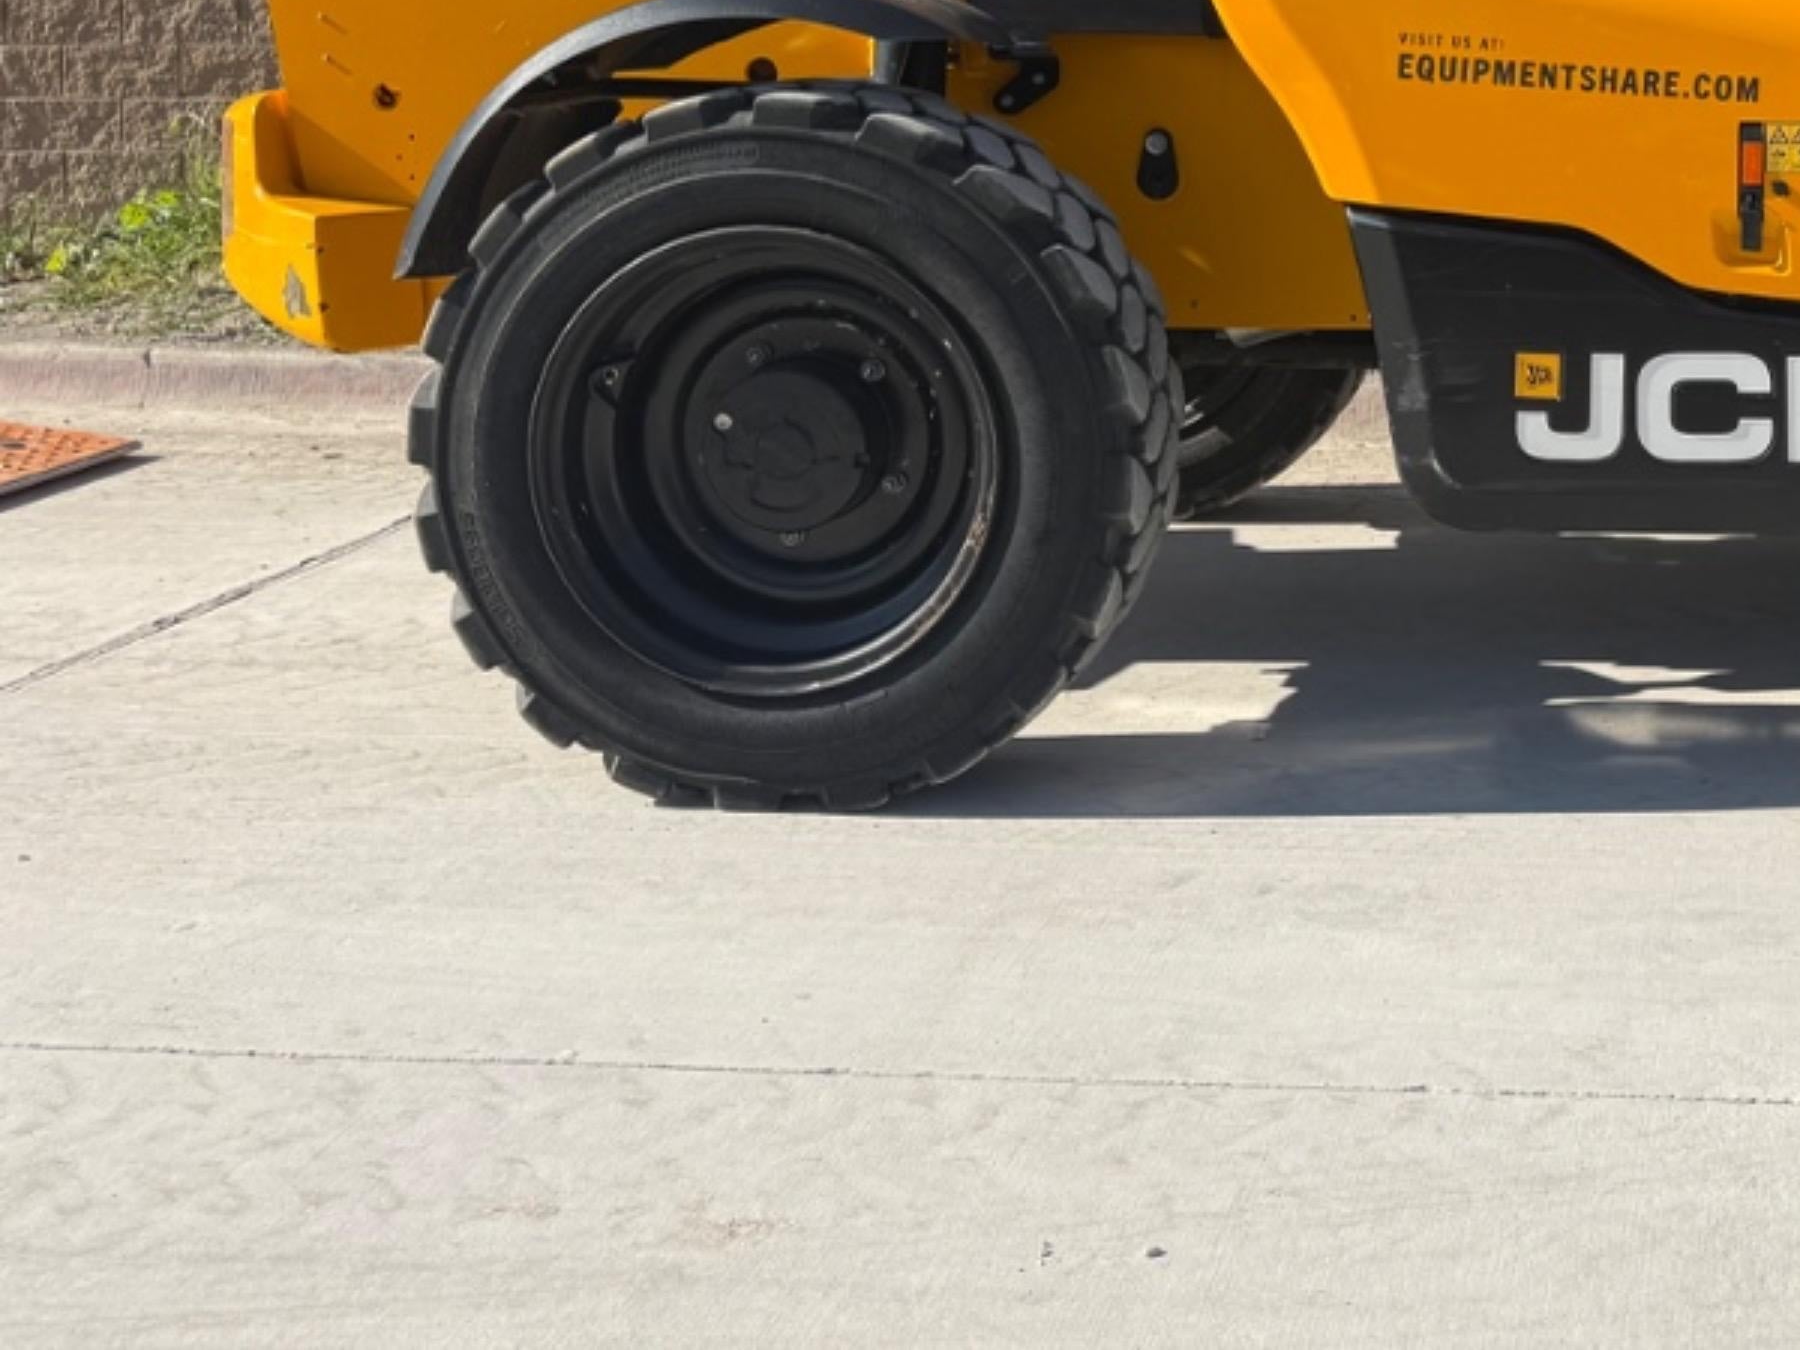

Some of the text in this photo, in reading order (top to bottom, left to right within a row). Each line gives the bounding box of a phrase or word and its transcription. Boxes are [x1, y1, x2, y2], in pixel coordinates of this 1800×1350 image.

[1399, 32, 1443, 47] VISIT
[1451, 36, 1473, 49] US
[1397, 53, 1760, 103] EQUIPMENTSHARE.COM
